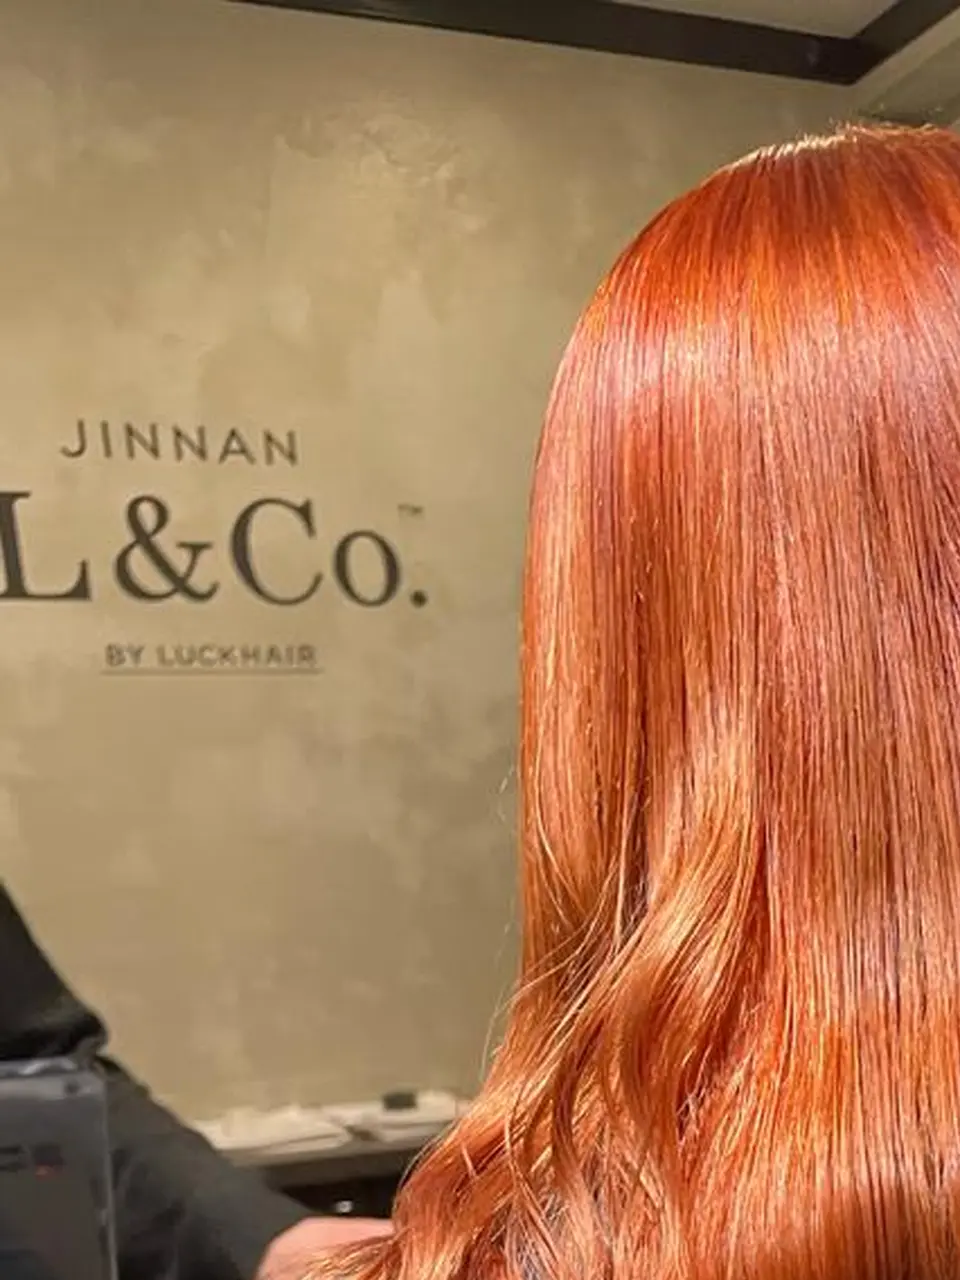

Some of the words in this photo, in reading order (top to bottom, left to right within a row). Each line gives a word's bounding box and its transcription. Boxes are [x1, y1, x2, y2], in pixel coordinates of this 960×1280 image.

[59, 418, 300, 467] JINNAN
[105, 643, 145, 667] BY
[156, 643, 318, 668] LUCKHAIR
